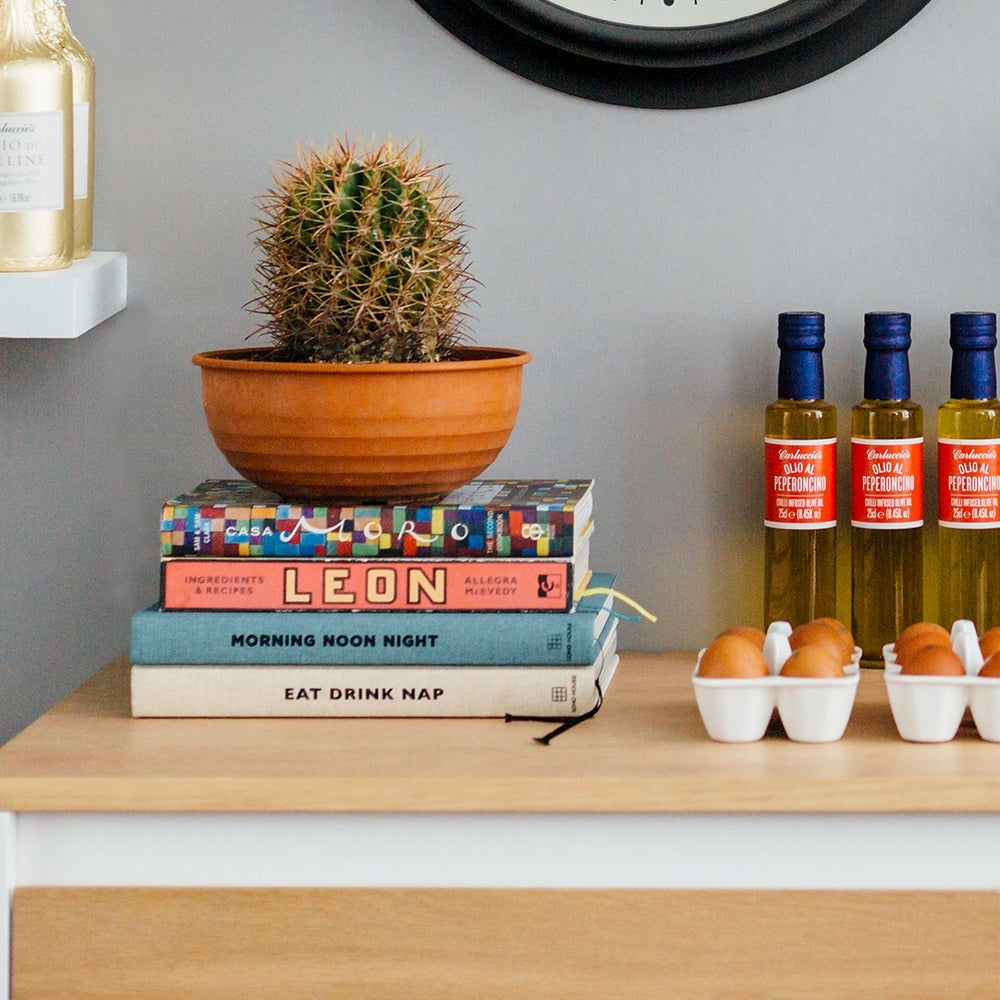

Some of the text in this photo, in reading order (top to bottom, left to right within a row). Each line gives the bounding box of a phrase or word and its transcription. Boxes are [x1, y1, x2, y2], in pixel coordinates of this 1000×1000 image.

[778, 449, 822, 461] Carluccio's
[867, 449, 910, 461] Carluccio's
[952, 449, 996, 461] Carluccio's
[784, 462, 815, 475] OLIO AL
[872, 462, 903, 475] OLIO AL
[958, 462, 990, 475] OLIO AL
[774, 476, 826, 492] PEPERONCINO
[862, 476, 915, 492] PEPERONCINO
[948, 476, 1000, 492] PEPERONCINO
[203, 522, 211, 543] CLARK
[226, 516, 469, 543] CASA MORO
[193, 537, 201, 551] SAM
[185, 576, 264, 584] INGREDIENTS
[283, 567, 447, 605] LEON
[231, 634, 438, 647] MORNING NOON NIGHT
[284, 688, 444, 700] EAT DRINK NAP
